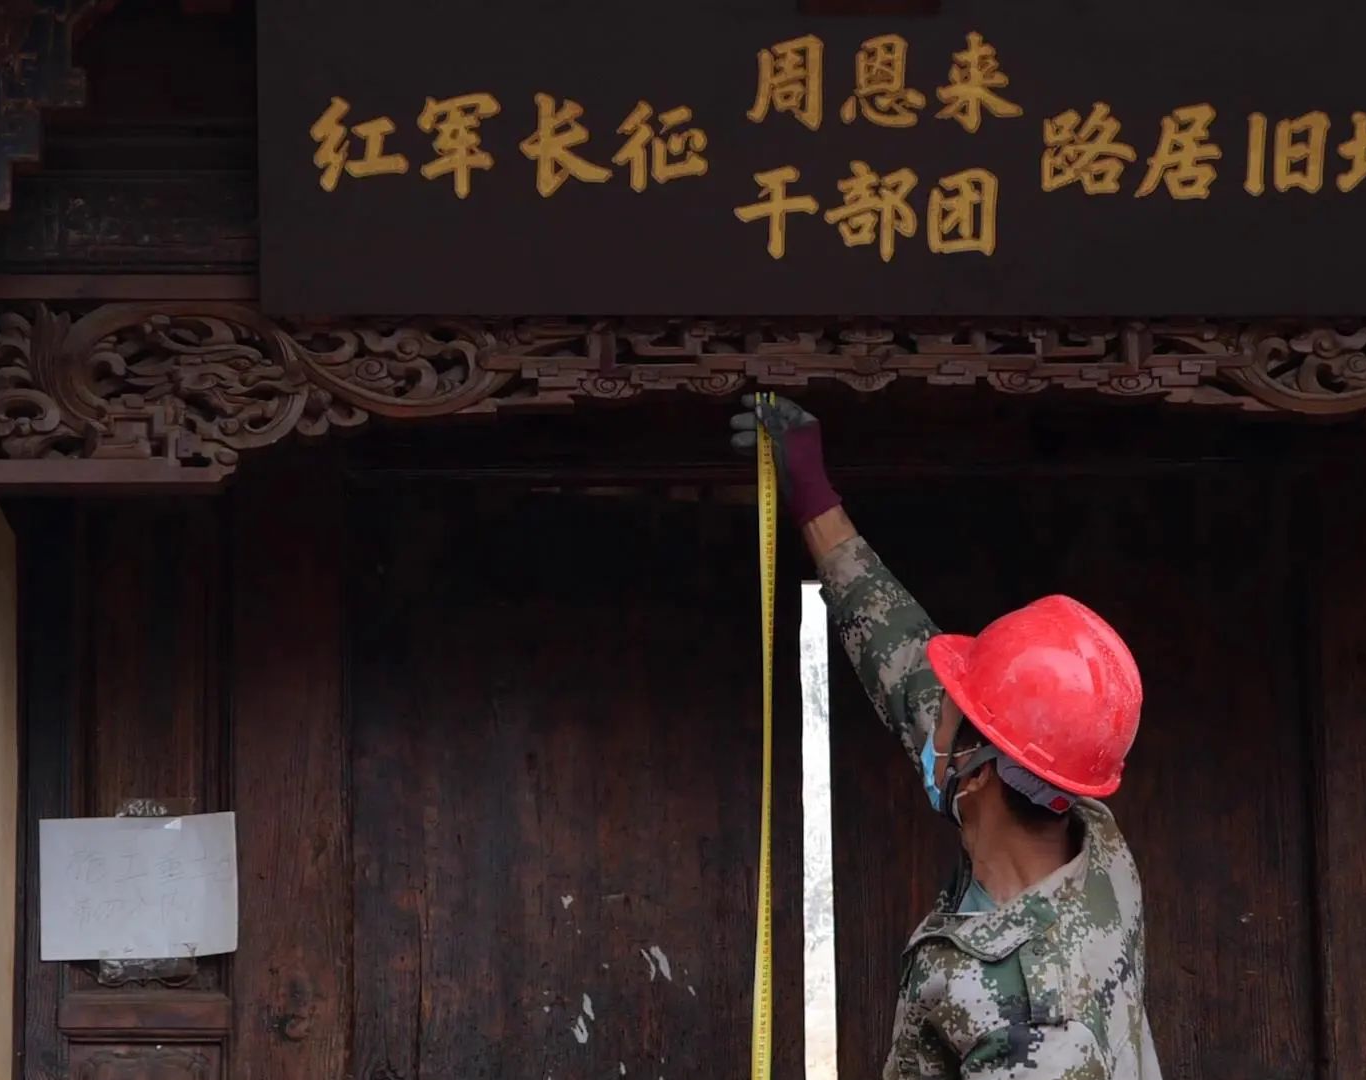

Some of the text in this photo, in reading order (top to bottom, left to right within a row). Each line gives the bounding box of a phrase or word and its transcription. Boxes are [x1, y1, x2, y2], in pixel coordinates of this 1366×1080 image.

[747, 32, 1024, 134] 周恩来
[309, 92, 709, 199] 红军长征
[735, 161, 999, 263] 干部团
